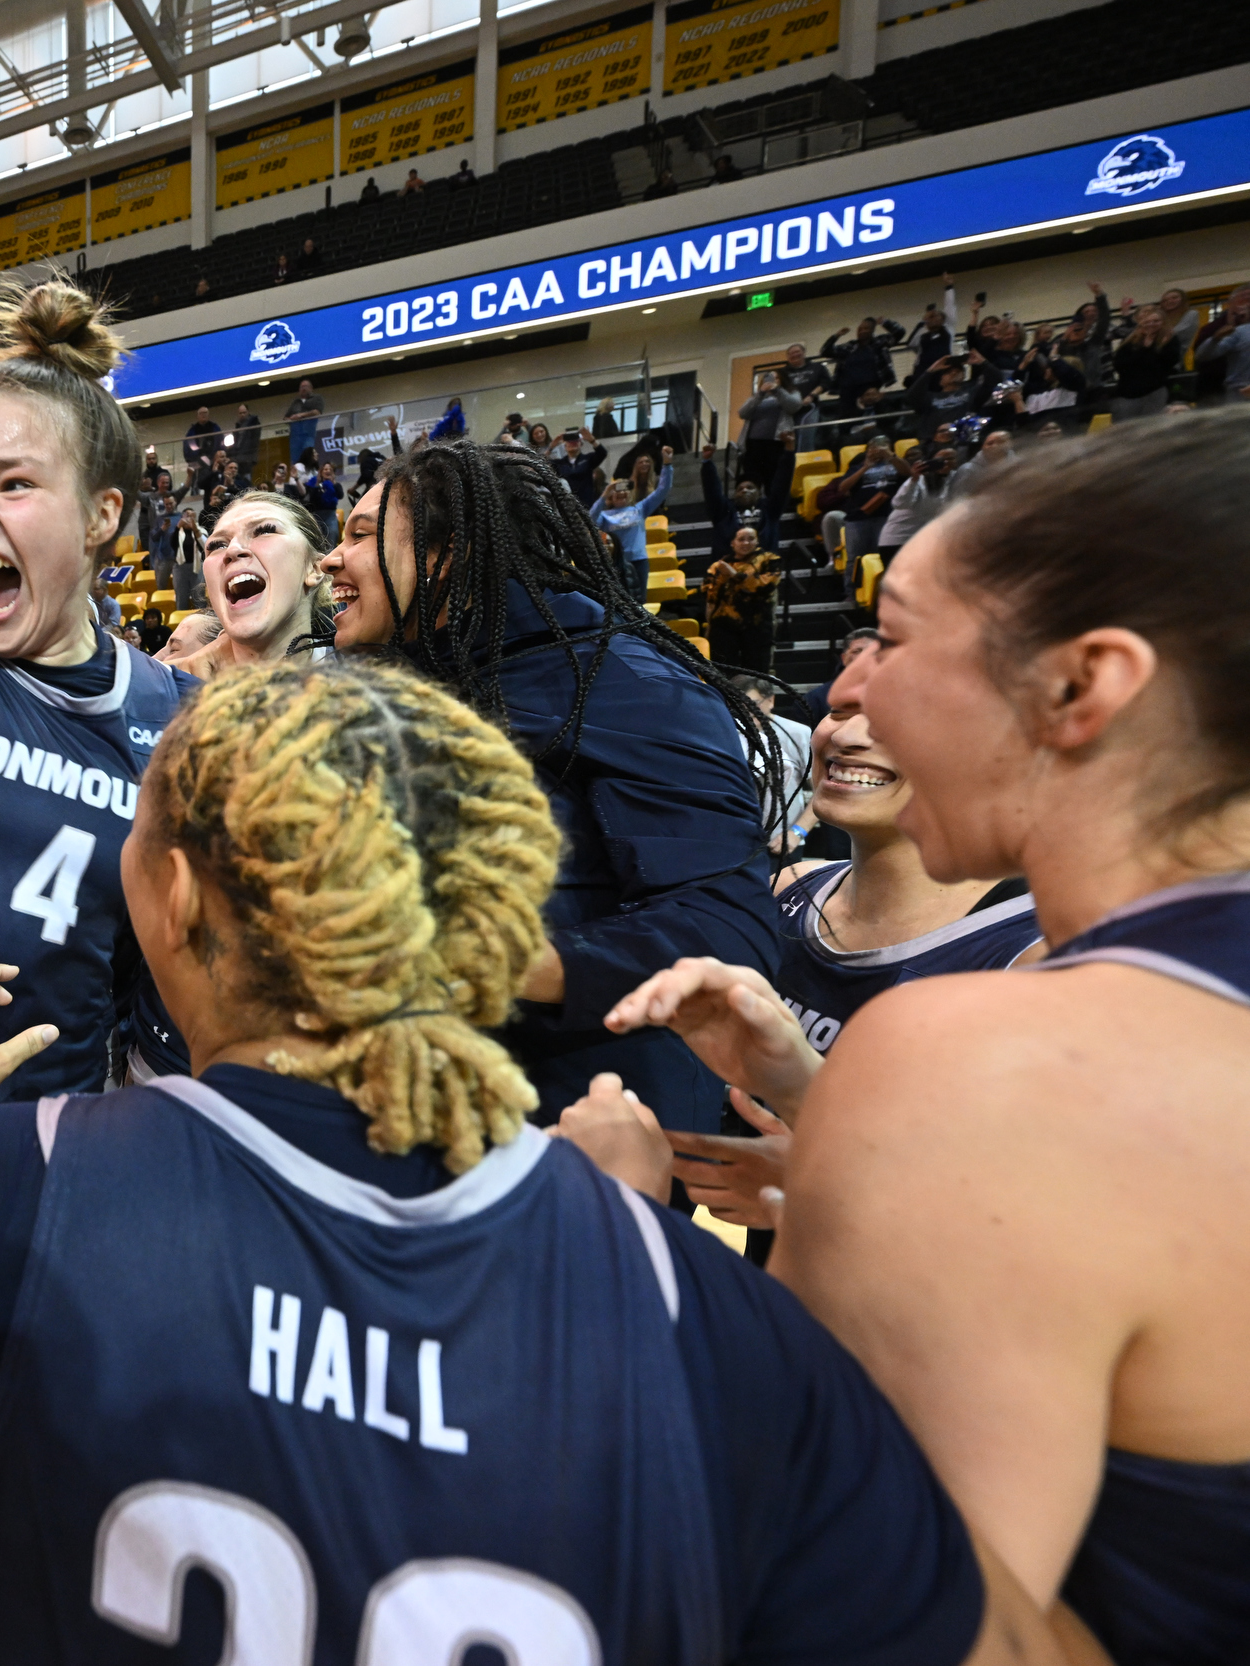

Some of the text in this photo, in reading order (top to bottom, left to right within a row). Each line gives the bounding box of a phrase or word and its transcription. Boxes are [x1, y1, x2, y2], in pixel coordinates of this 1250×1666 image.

[675, 11, 829, 66] 1997 1999 2000
[679, 20, 725, 43] NCAA
[511, 35, 638, 84] NCAA REGIONALS
[672, 46, 771, 84] 2021 2022
[506, 55, 642, 106] 1991 1992 1993
[506, 72, 638, 120] 1994 1995 1996
[352, 88, 462, 130] NCAA REGIONALS
[260, 134, 289, 150] NCAA
[349, 131, 379, 149] 1985
[390, 119, 422, 138] 1986
[389, 134, 420, 153] 1989
[432, 122, 465, 141] 1990
[259, 157, 288, 175] 1990
[1090, 166, 1182, 190] MONMOUTH
[129, 196, 155, 212] 2010
[362, 198, 895, 342] 2023 CAA CHAMPIONS
[10, 824, 97, 946] 4
[250, 1284, 468, 1455] HALL
